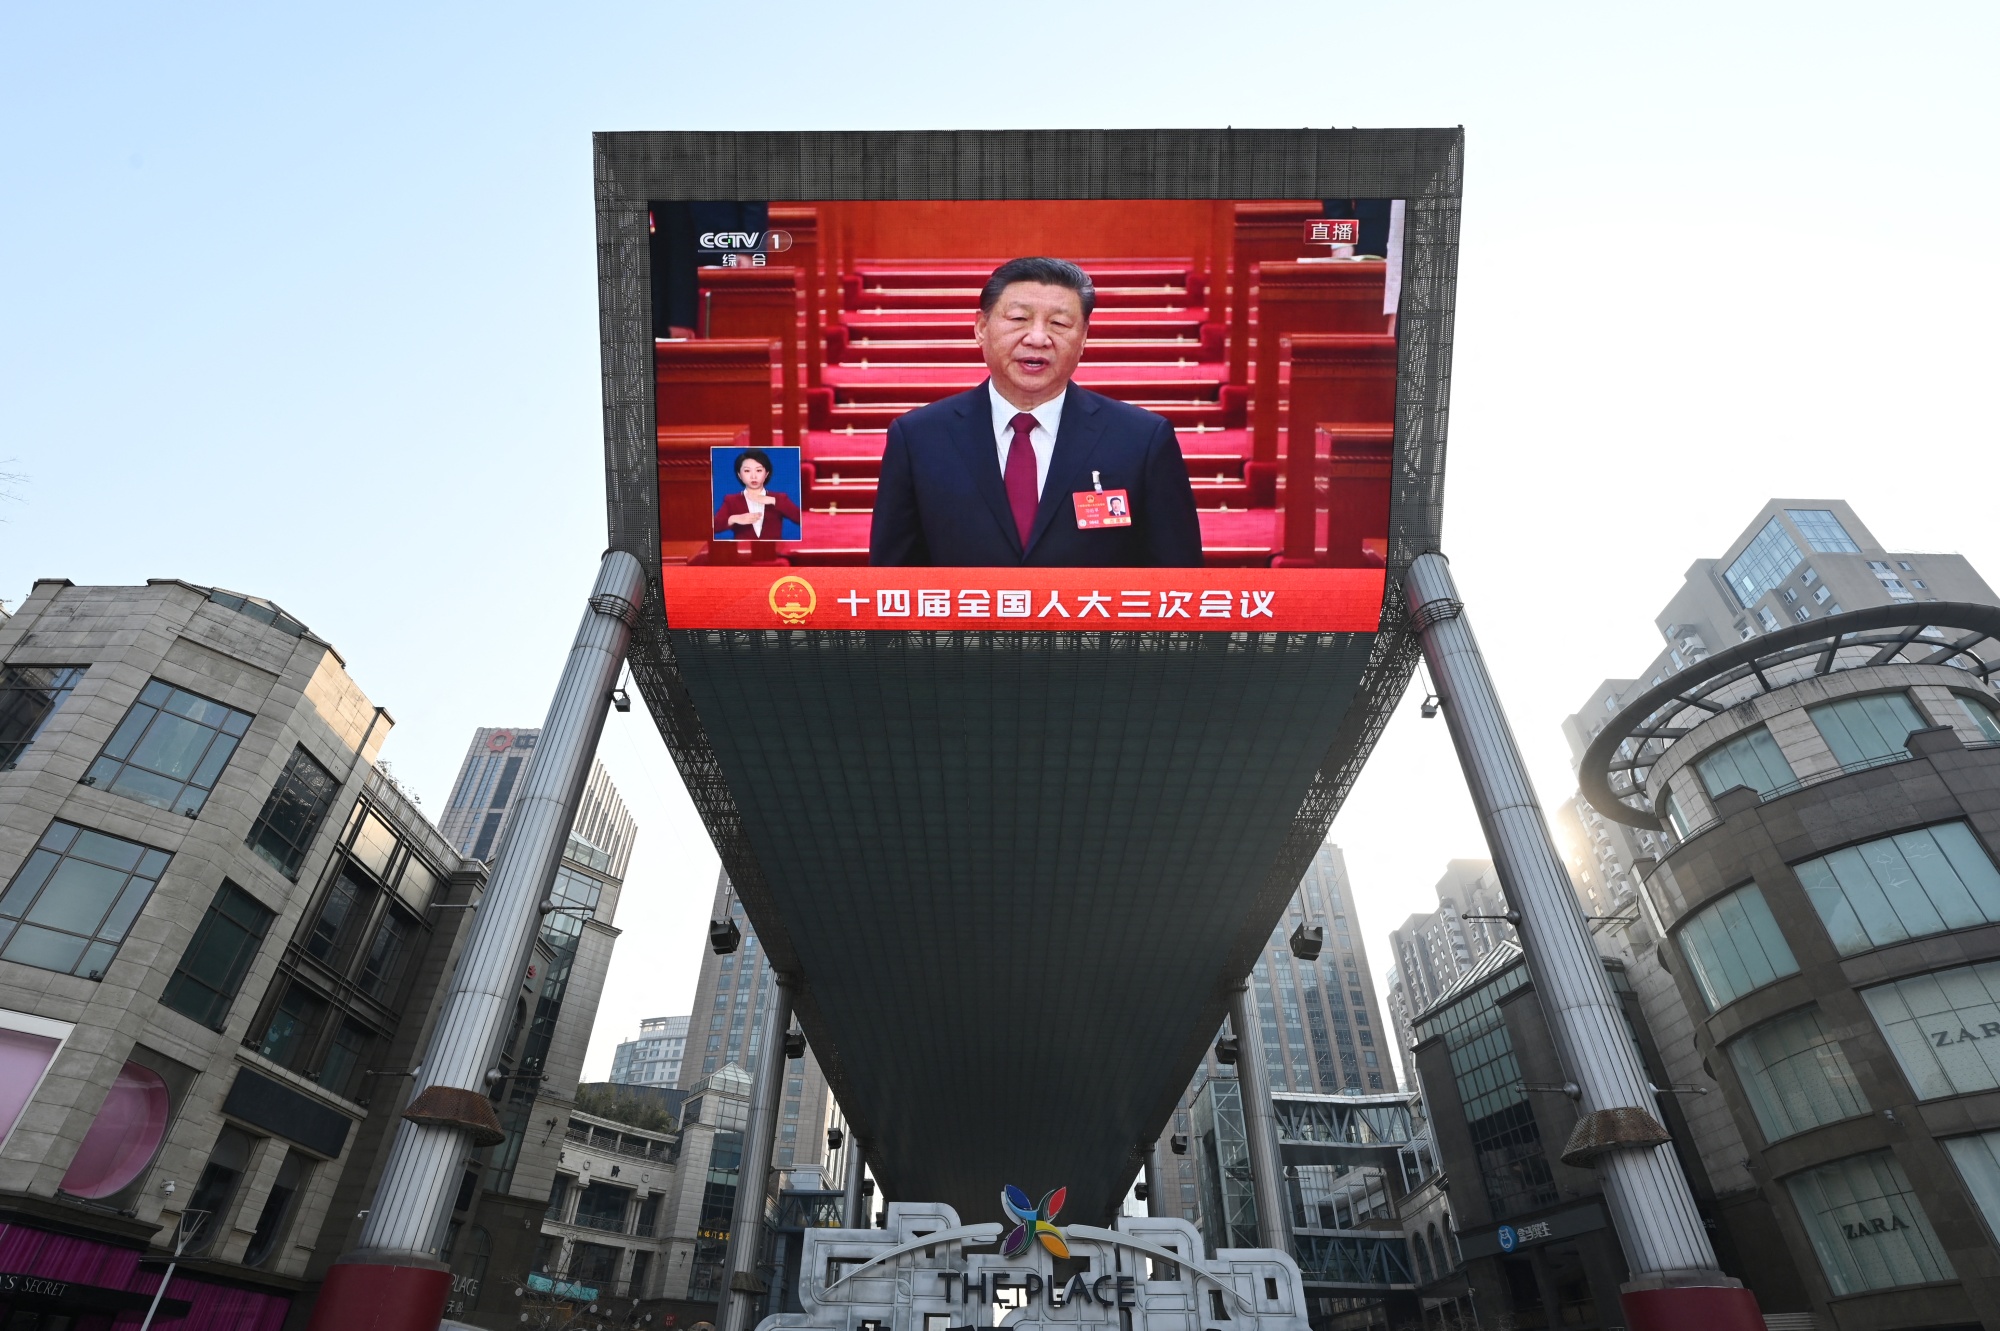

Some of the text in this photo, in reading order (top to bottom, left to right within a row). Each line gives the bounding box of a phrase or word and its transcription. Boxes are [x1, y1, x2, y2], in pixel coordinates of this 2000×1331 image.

[699, 232, 780, 249] CCTV 1
[1310, 222, 1353, 241] 直播
[722, 253, 766, 267] 综合
[837, 589, 1275, 619] 十四届全国人大三次会议
[1842, 1214, 1910, 1240] ZARA
[0, 1274, 69, 1297] 'S SECRET
[937, 1272, 1136, 1307] THE PLACE
